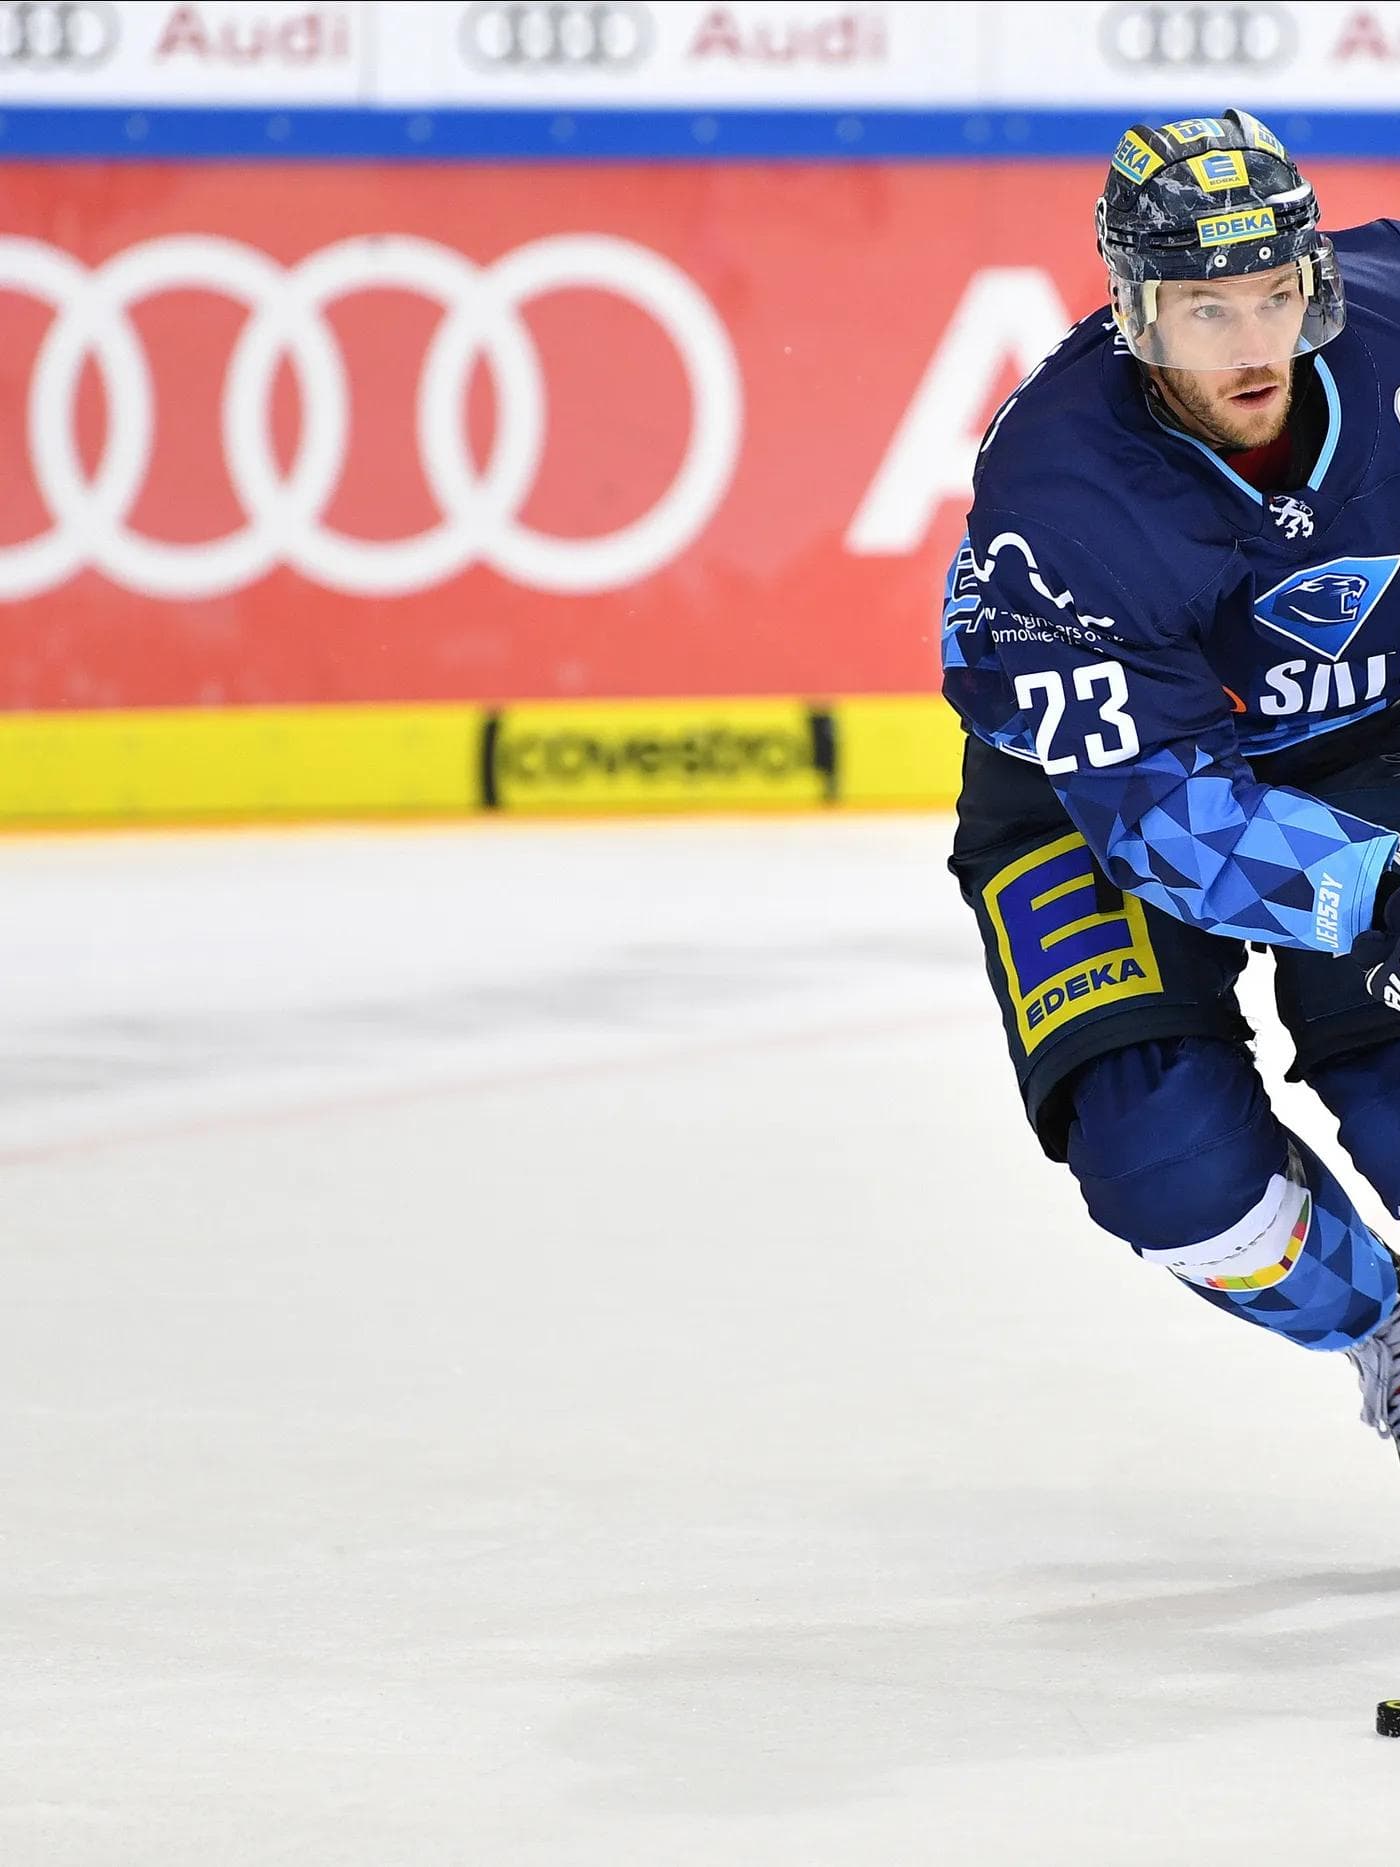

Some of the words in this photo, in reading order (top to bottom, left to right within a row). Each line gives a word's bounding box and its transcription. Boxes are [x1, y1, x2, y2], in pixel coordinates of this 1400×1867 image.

[154, 5, 351, 62] Audi
[686, 7, 890, 63] Audi
[1201, 213, 1273, 238] EDEKA
[1013, 660, 1141, 776] 23
[1026, 958, 1147, 1030] EDEKA
